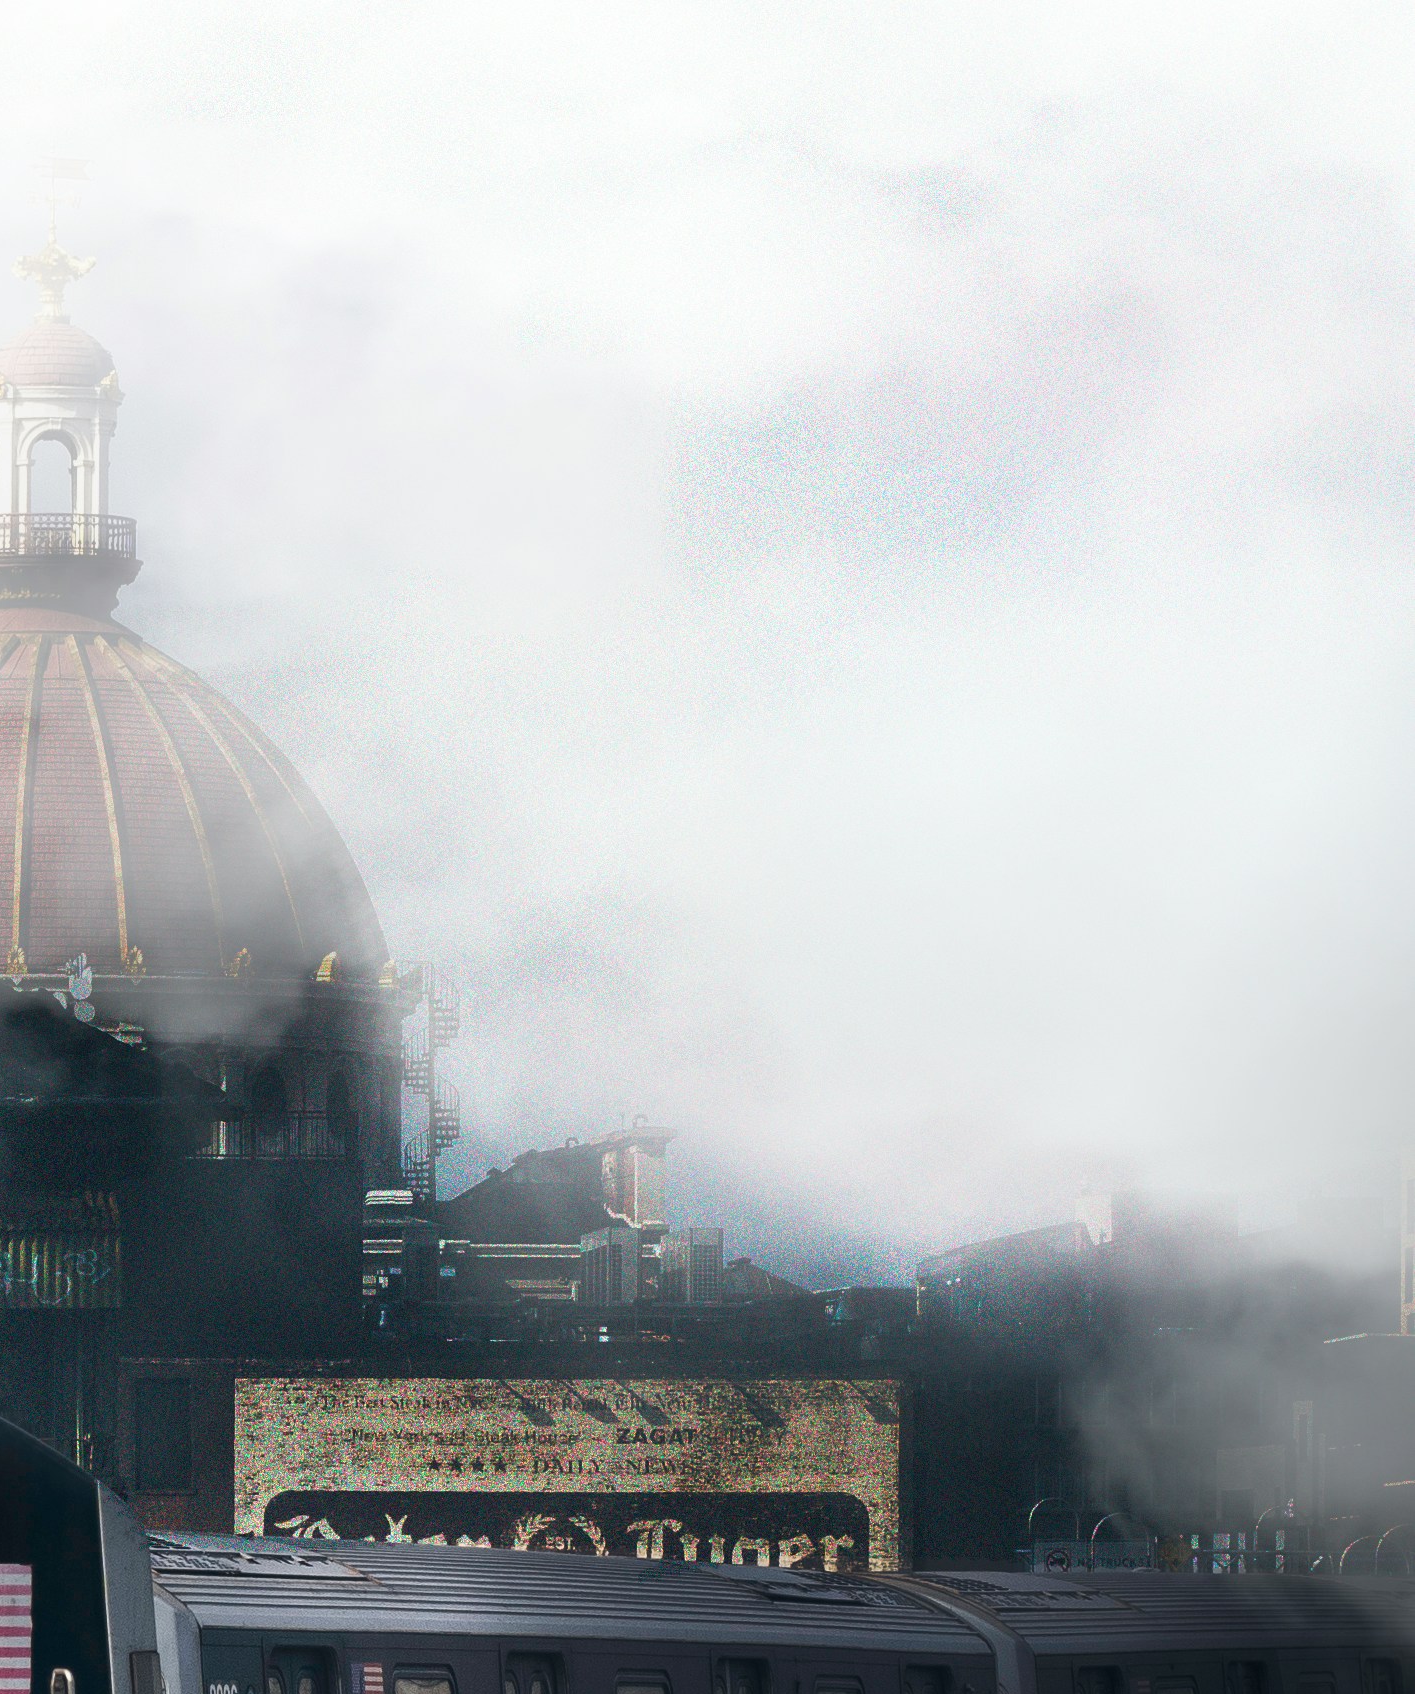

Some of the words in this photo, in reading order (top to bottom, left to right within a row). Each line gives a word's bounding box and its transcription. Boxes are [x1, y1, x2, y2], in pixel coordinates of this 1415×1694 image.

[616, 1428, 697, 1445] ZAGAT
[532, 1459, 604, 1475] DAILY
[627, 1459, 695, 1476] NEWS
